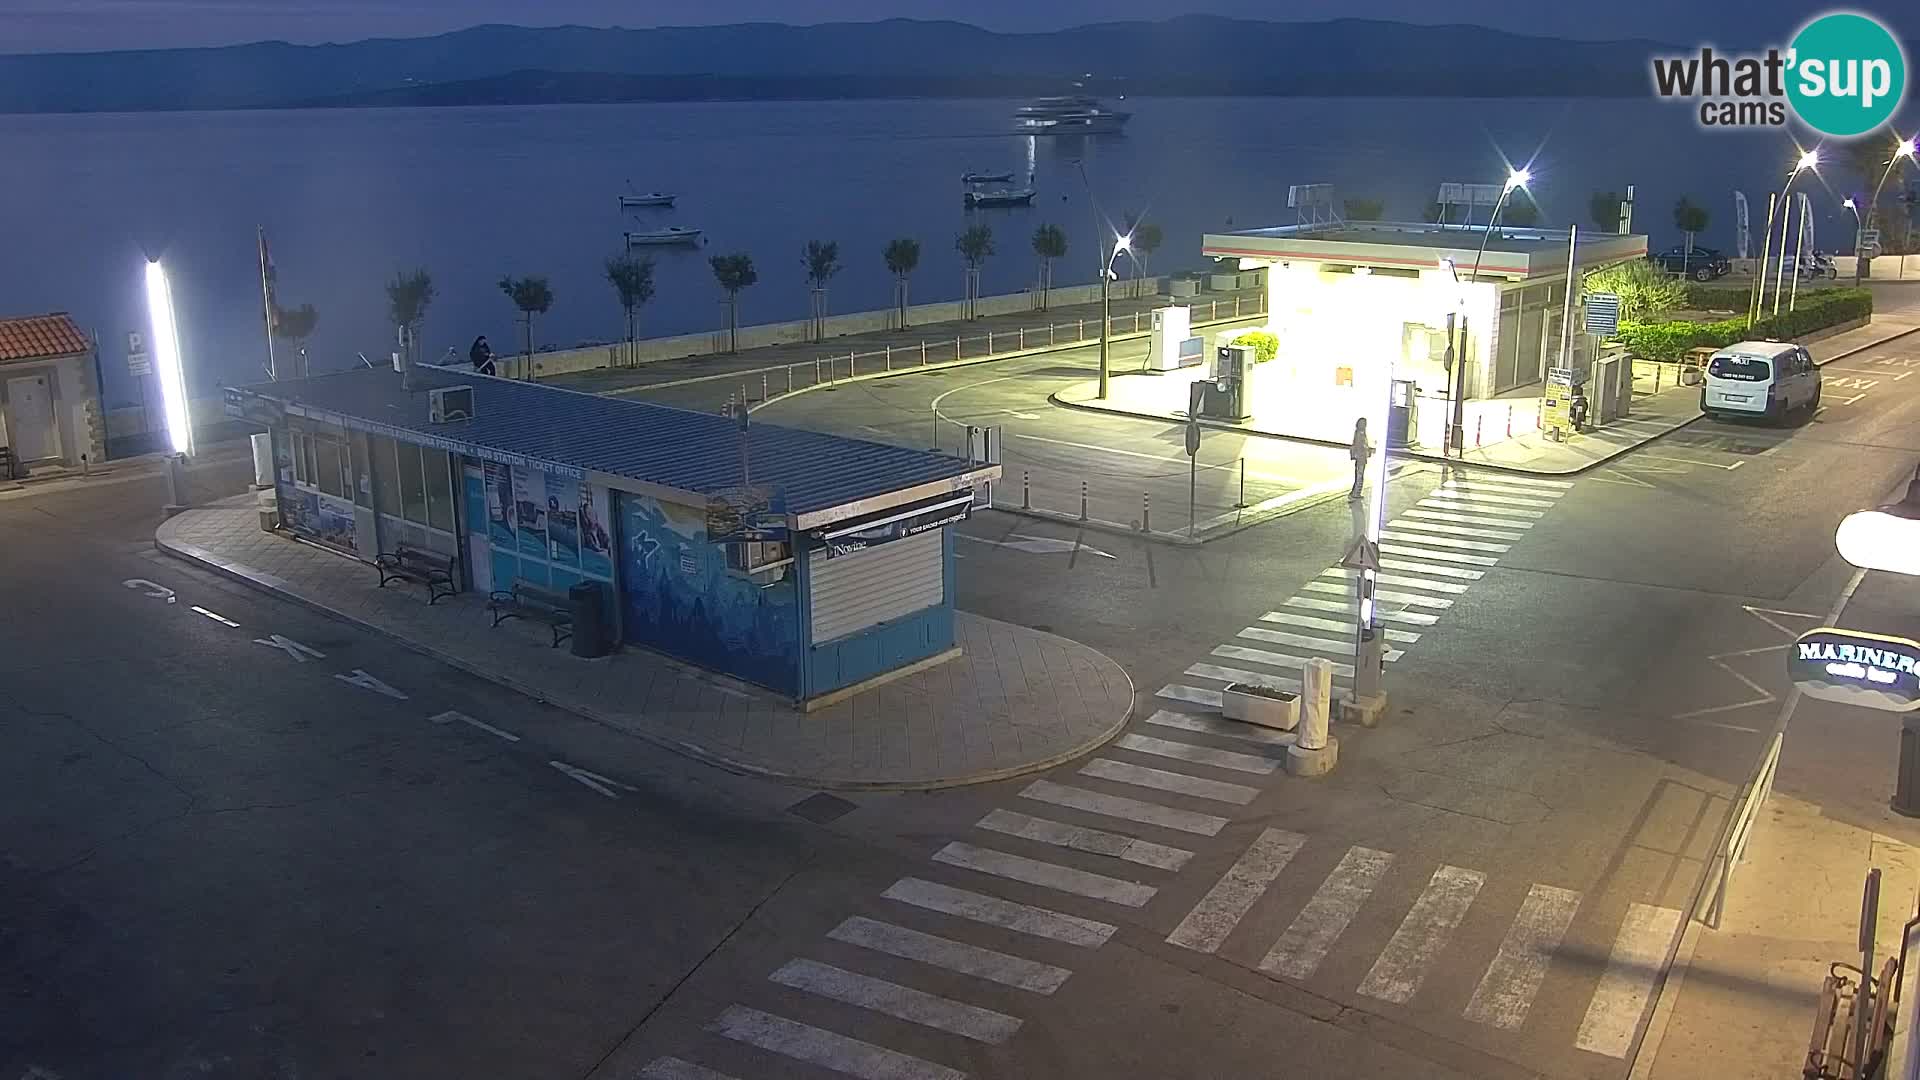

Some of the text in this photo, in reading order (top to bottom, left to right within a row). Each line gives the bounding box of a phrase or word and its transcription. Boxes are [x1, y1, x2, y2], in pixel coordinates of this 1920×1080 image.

[129, 334, 142, 350] P
[477, 448, 492, 460] BUS
[494, 451, 526, 467] STATION
[527, 459, 554, 473] TICKET
[555, 464, 582, 480] OFFICE
